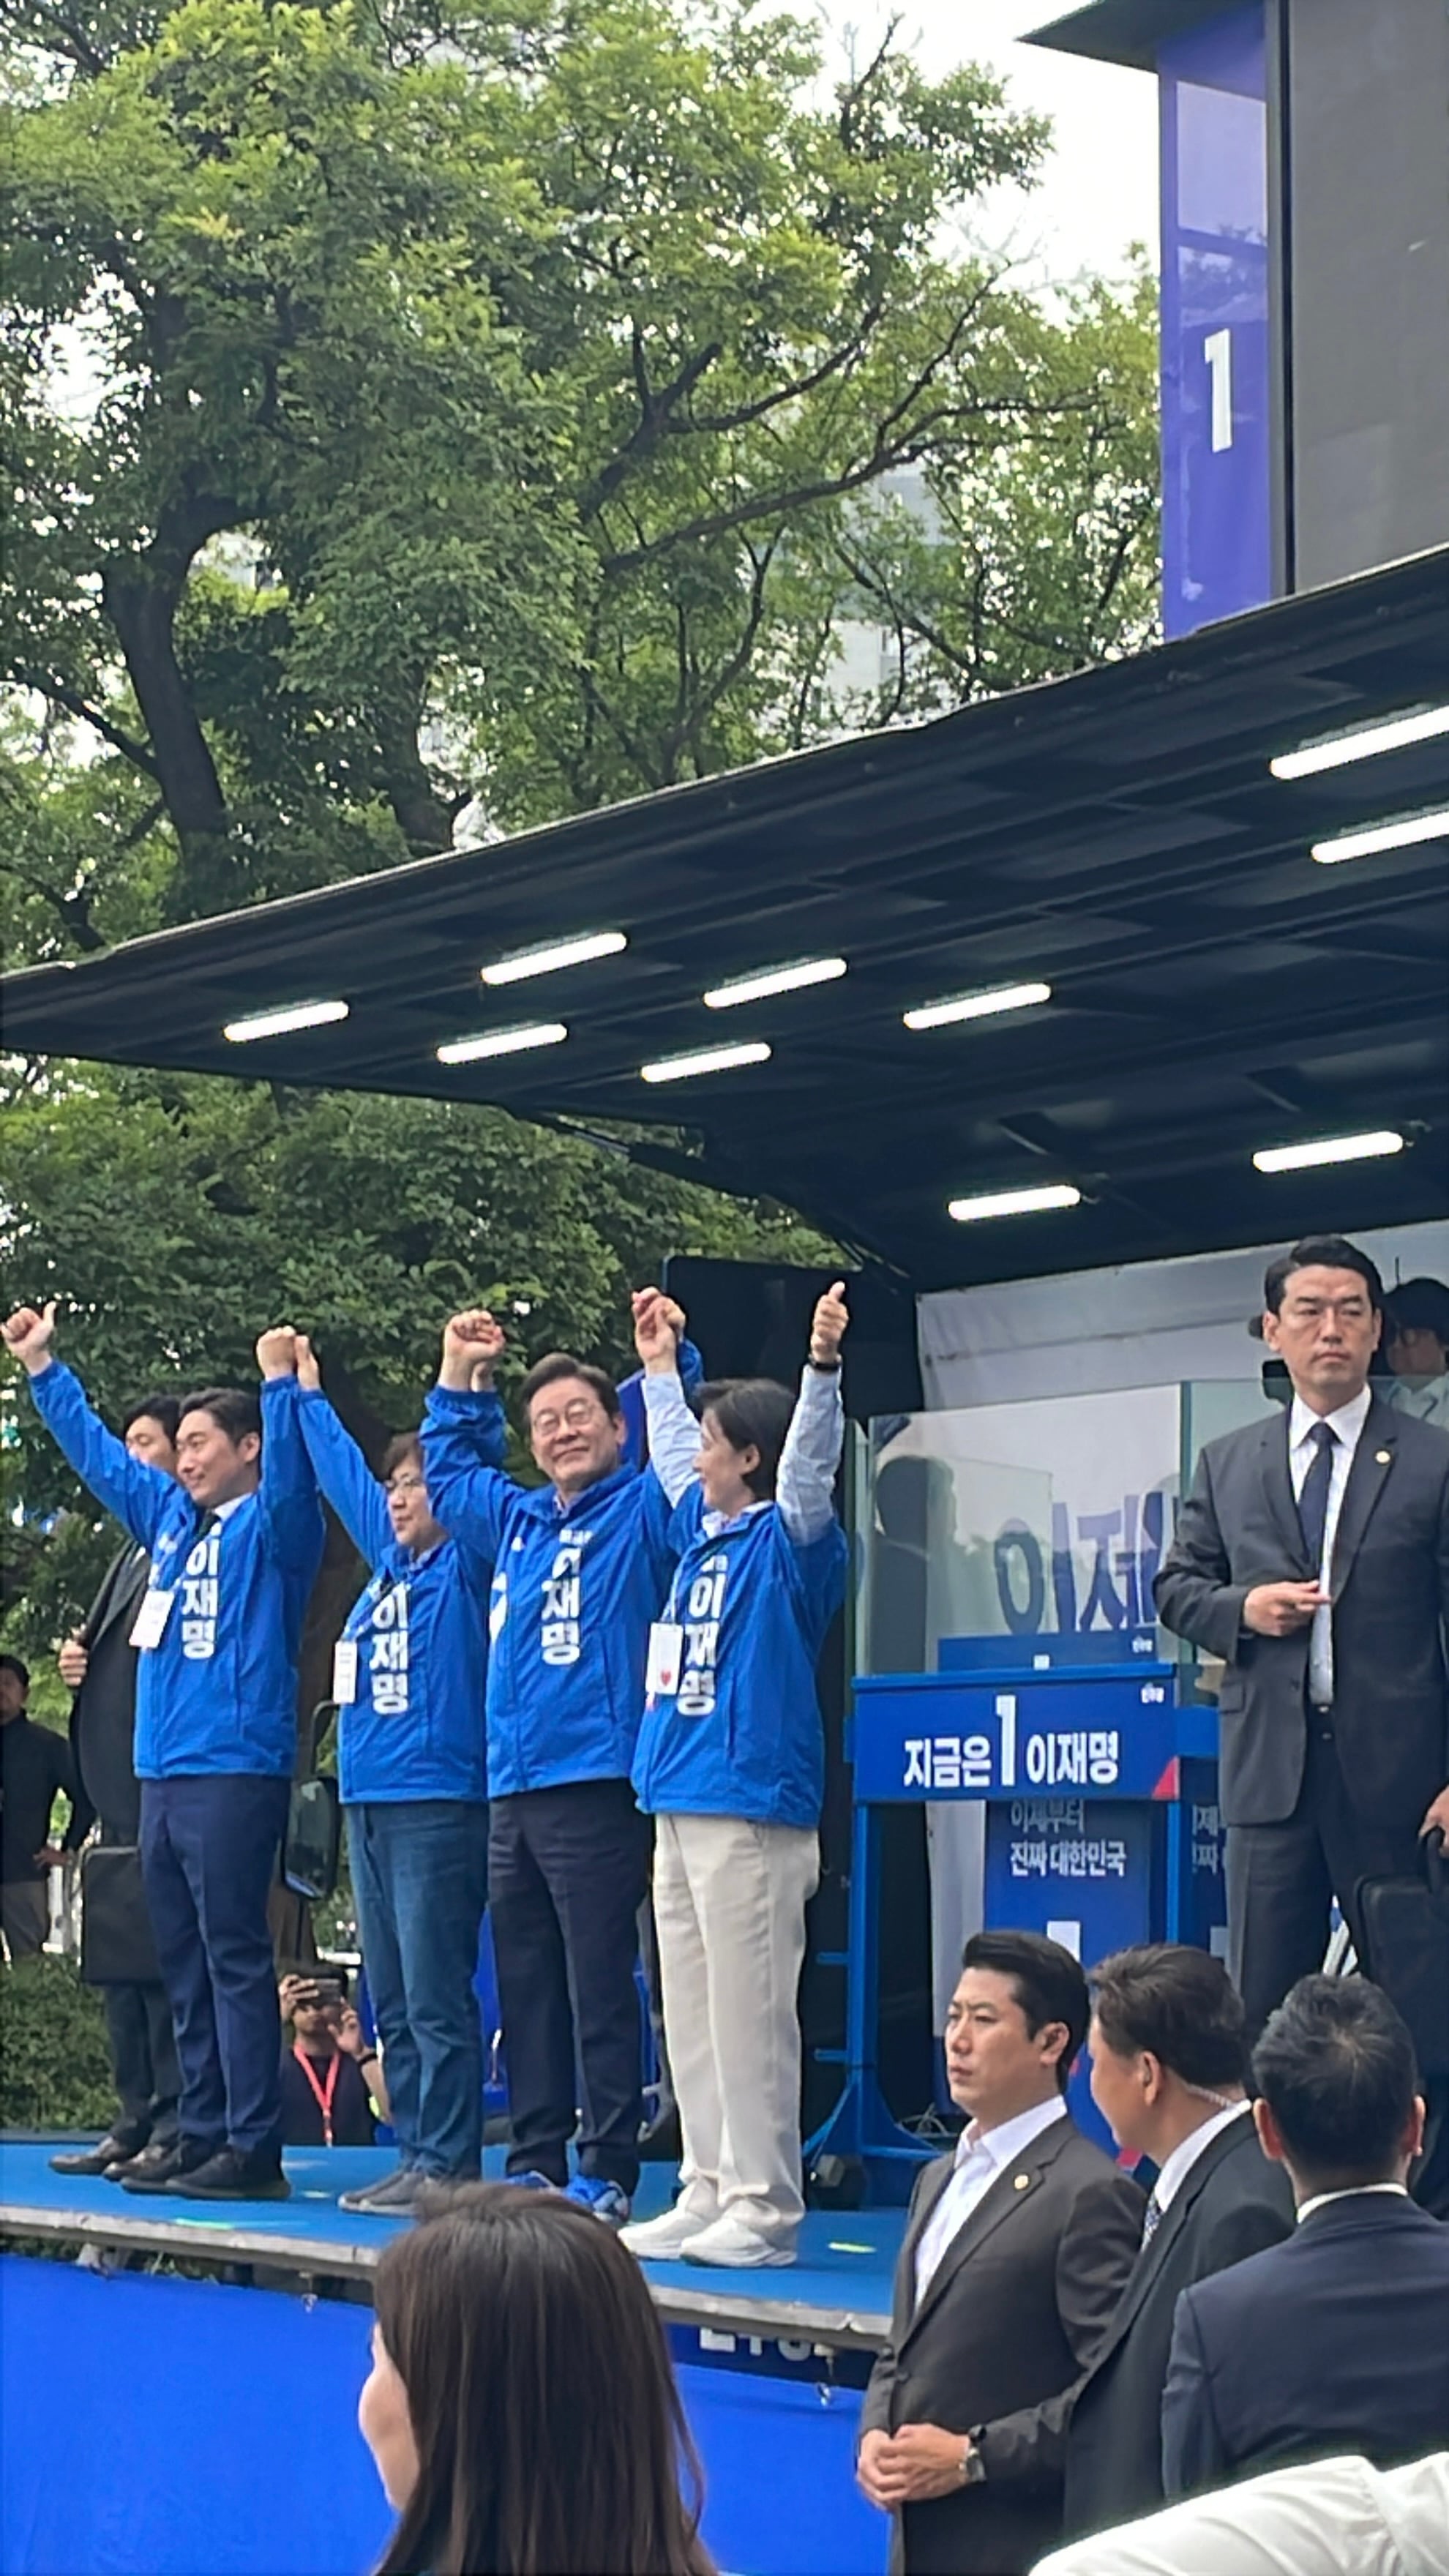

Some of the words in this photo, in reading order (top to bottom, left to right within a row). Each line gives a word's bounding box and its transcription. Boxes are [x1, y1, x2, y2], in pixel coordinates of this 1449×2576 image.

[1205, 329, 1232, 452] 1
[182, 1538, 220, 1659] 이재명
[369, 1581, 408, 1714] 이재명
[542, 1547, 582, 1665] 이재명
[677, 1573, 726, 1715] 이재명
[903, 1735, 992, 1788] 지금은
[995, 1694, 1016, 1786] 1
[1026, 1731, 1119, 1784] 이재명
[1011, 1839, 1047, 1876] 진짜
[1050, 1838, 1127, 1878] 대한민국
